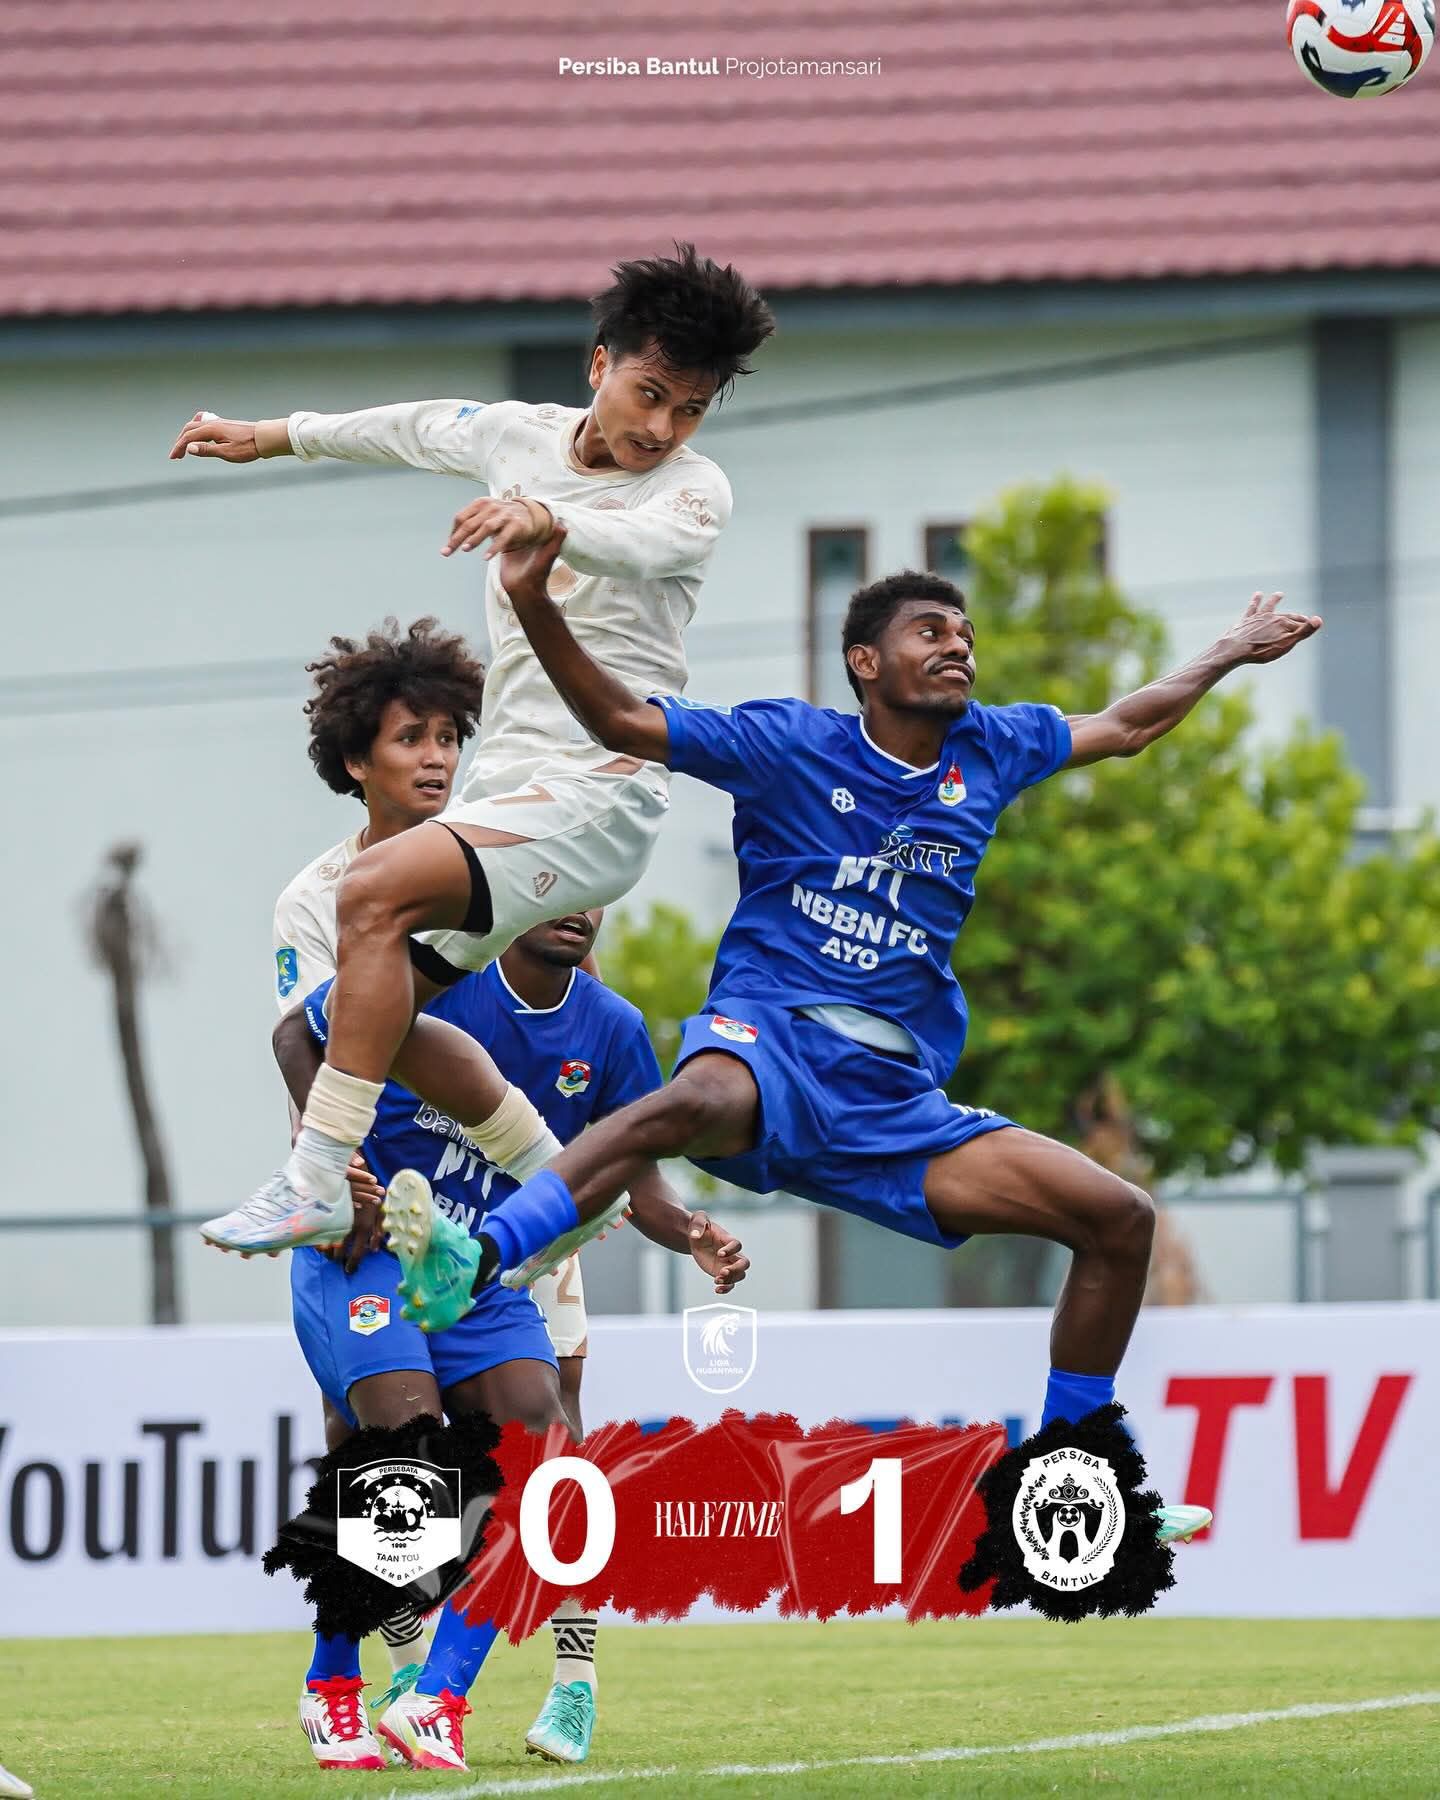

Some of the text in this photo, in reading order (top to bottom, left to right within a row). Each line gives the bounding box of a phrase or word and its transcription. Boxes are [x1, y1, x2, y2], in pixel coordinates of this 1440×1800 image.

[832, 856, 911, 911] NTT
[791, 884, 929, 956] NBBN FC
[820, 936, 879, 970] AYO
[433, 1141, 508, 1200] NTT
[0, 1415, 322, 1562] ouTub
[1164, 1375, 1413, 1540] TV
